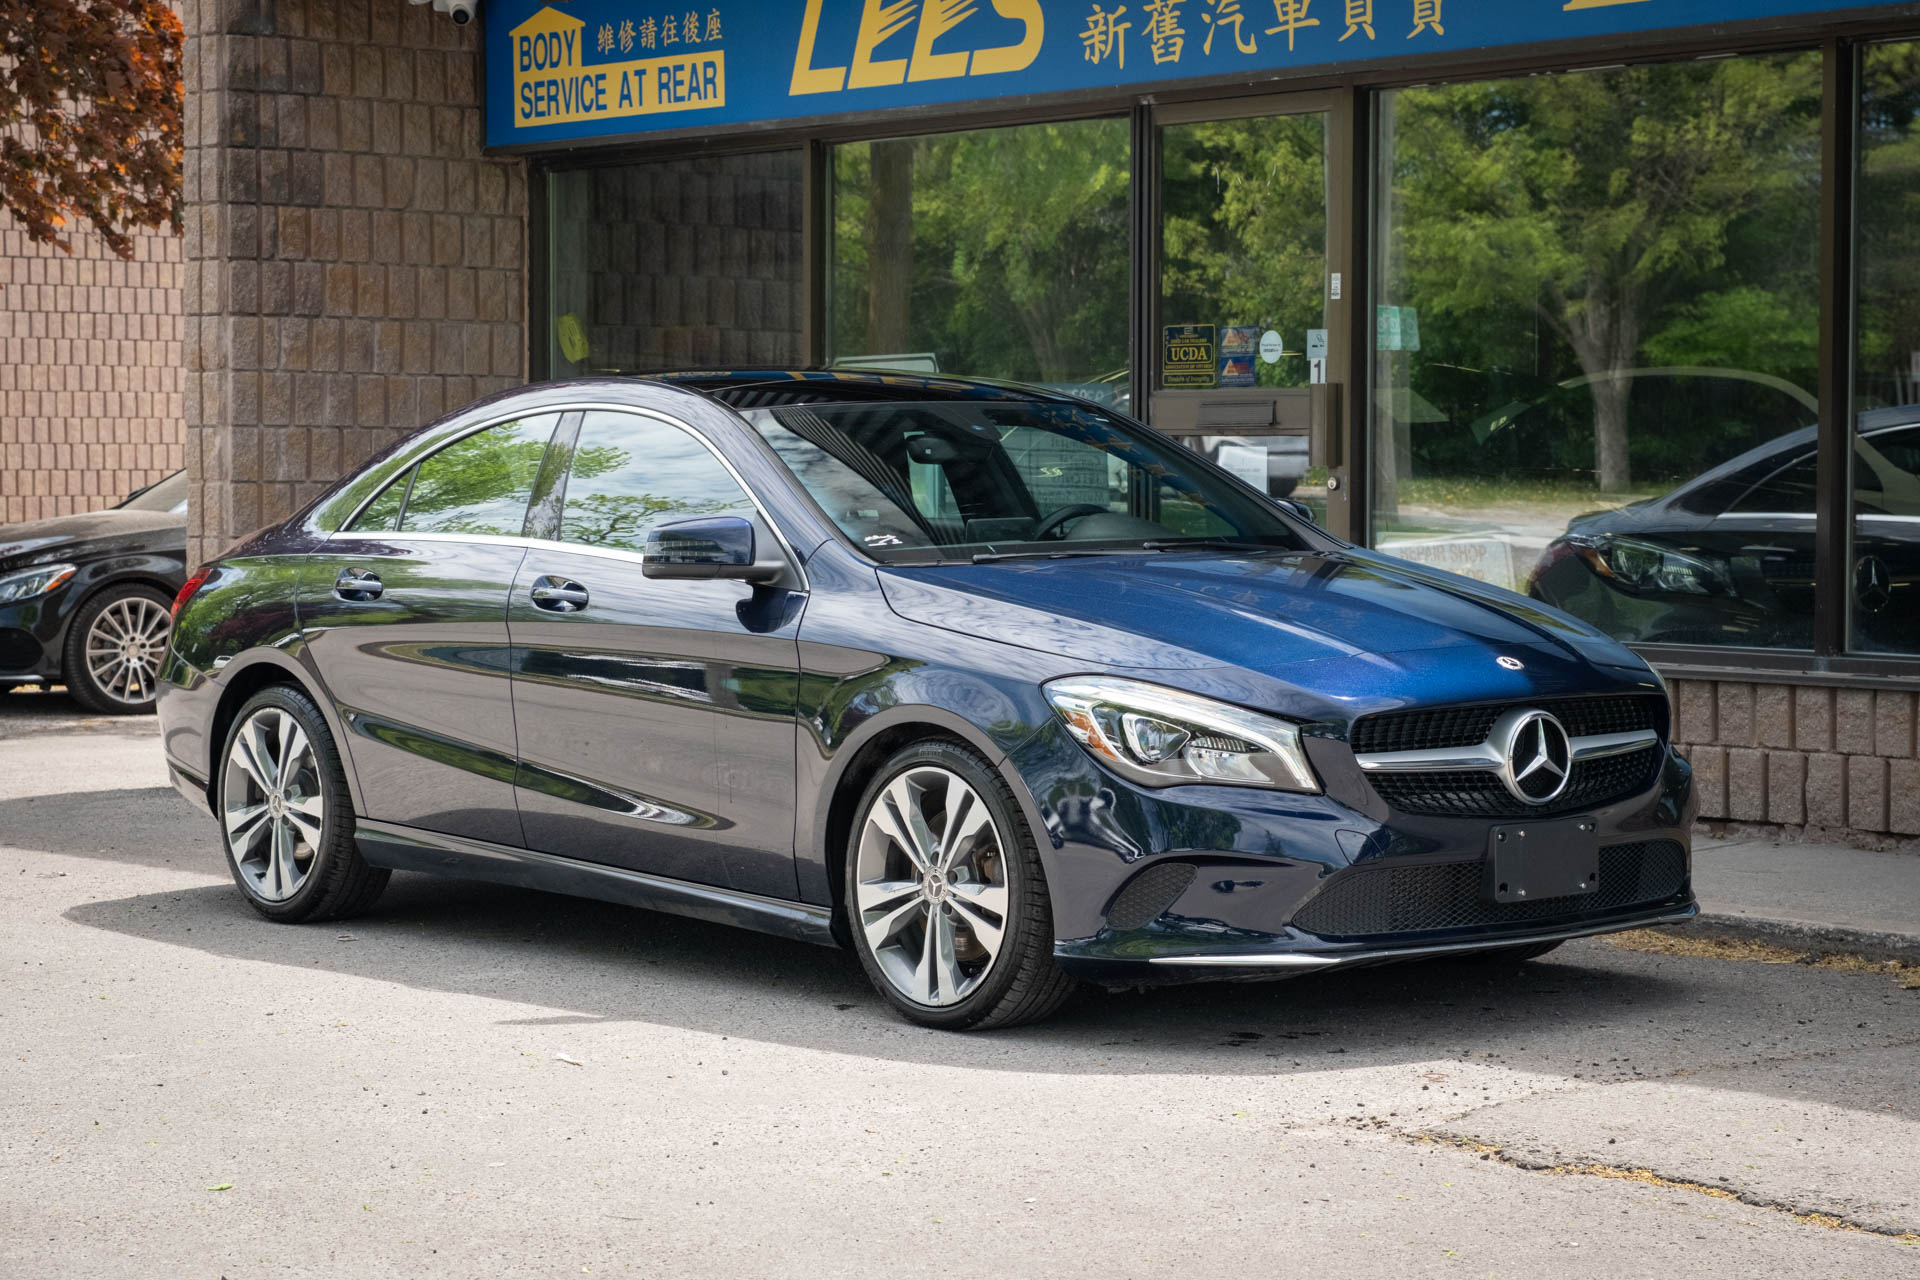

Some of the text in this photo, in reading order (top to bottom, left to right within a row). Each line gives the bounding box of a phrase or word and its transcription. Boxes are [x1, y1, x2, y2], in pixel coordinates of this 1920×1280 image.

[520, 28, 576, 72] BODY
[597, 8, 722, 55] 維修請往後座
[520, 60, 718, 119] SERVICE AT REAR
[1171, 346, 1208, 361] UCDA
